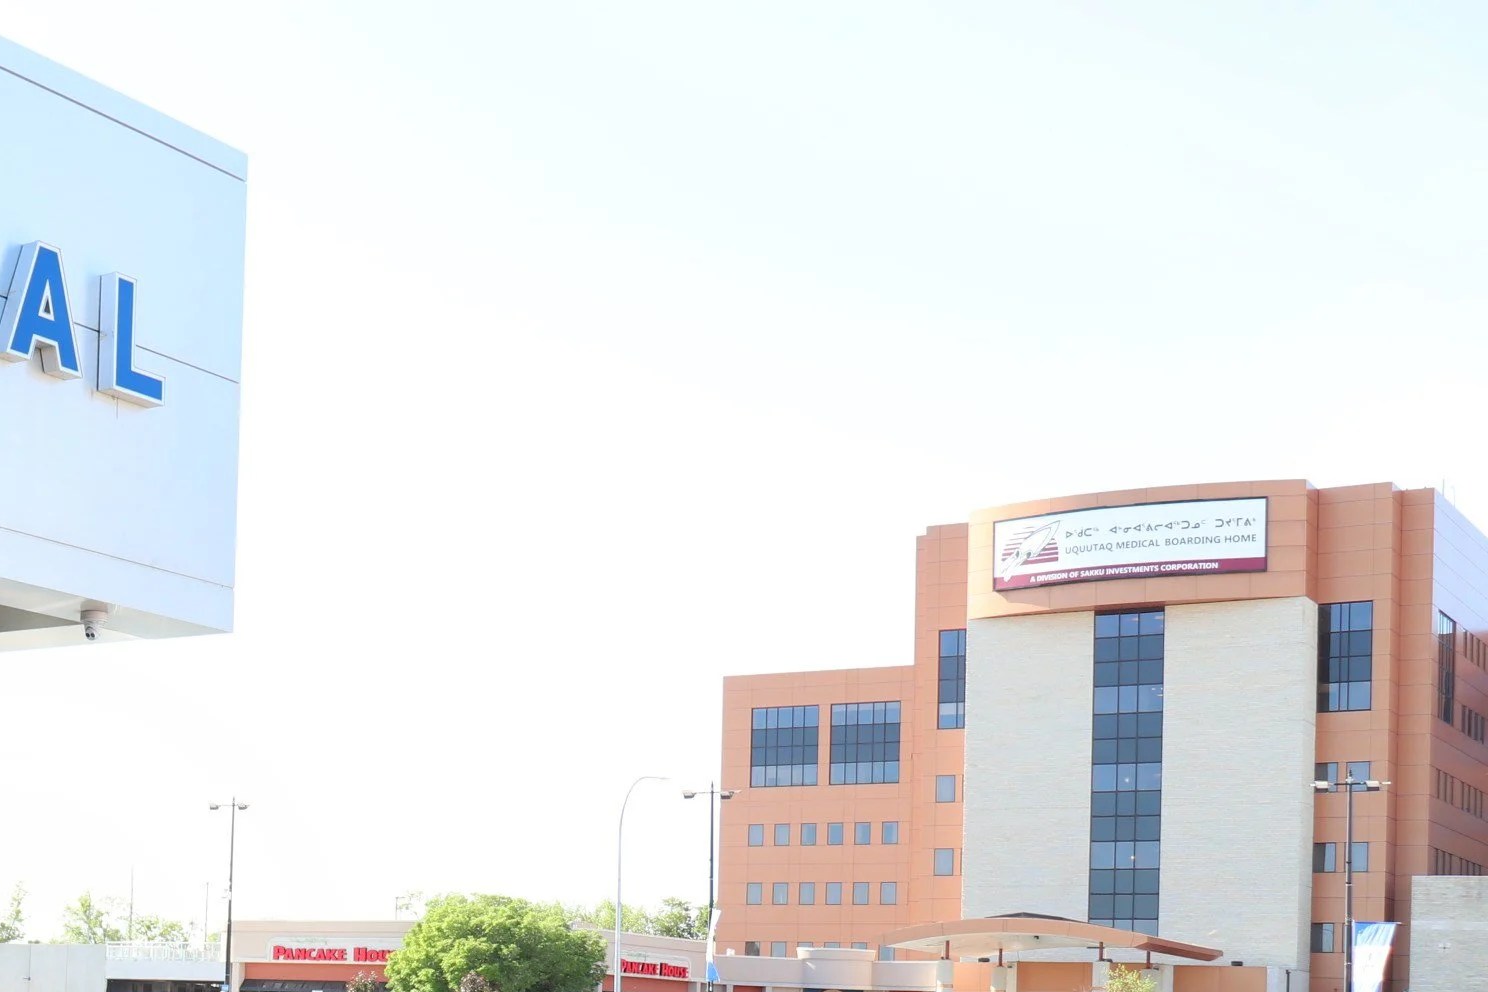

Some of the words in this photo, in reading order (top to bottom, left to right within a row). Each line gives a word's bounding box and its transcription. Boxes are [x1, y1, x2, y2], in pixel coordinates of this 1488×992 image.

[1065, 542, 1114, 555] UQUUTAQ
[1115, 539, 1160, 550] MEDICAL
[1164, 535, 1221, 547] BOARDING
[1224, 533, 1257, 544] HOME
[1036, 572, 1068, 582] DIVISION
[1069, 571, 1080, 579] OF
[1080, 568, 1105, 578] SAKKU
[1105, 564, 1159, 575] INVESTMENTS
[1160, 562, 1219, 572] CORPORATION
[272, 945, 347, 961] PANCAKE
[353, 947, 396, 962] HOU
[620, 958, 659, 976] PANCAKE
[659, 962, 689, 978] HOUSE
